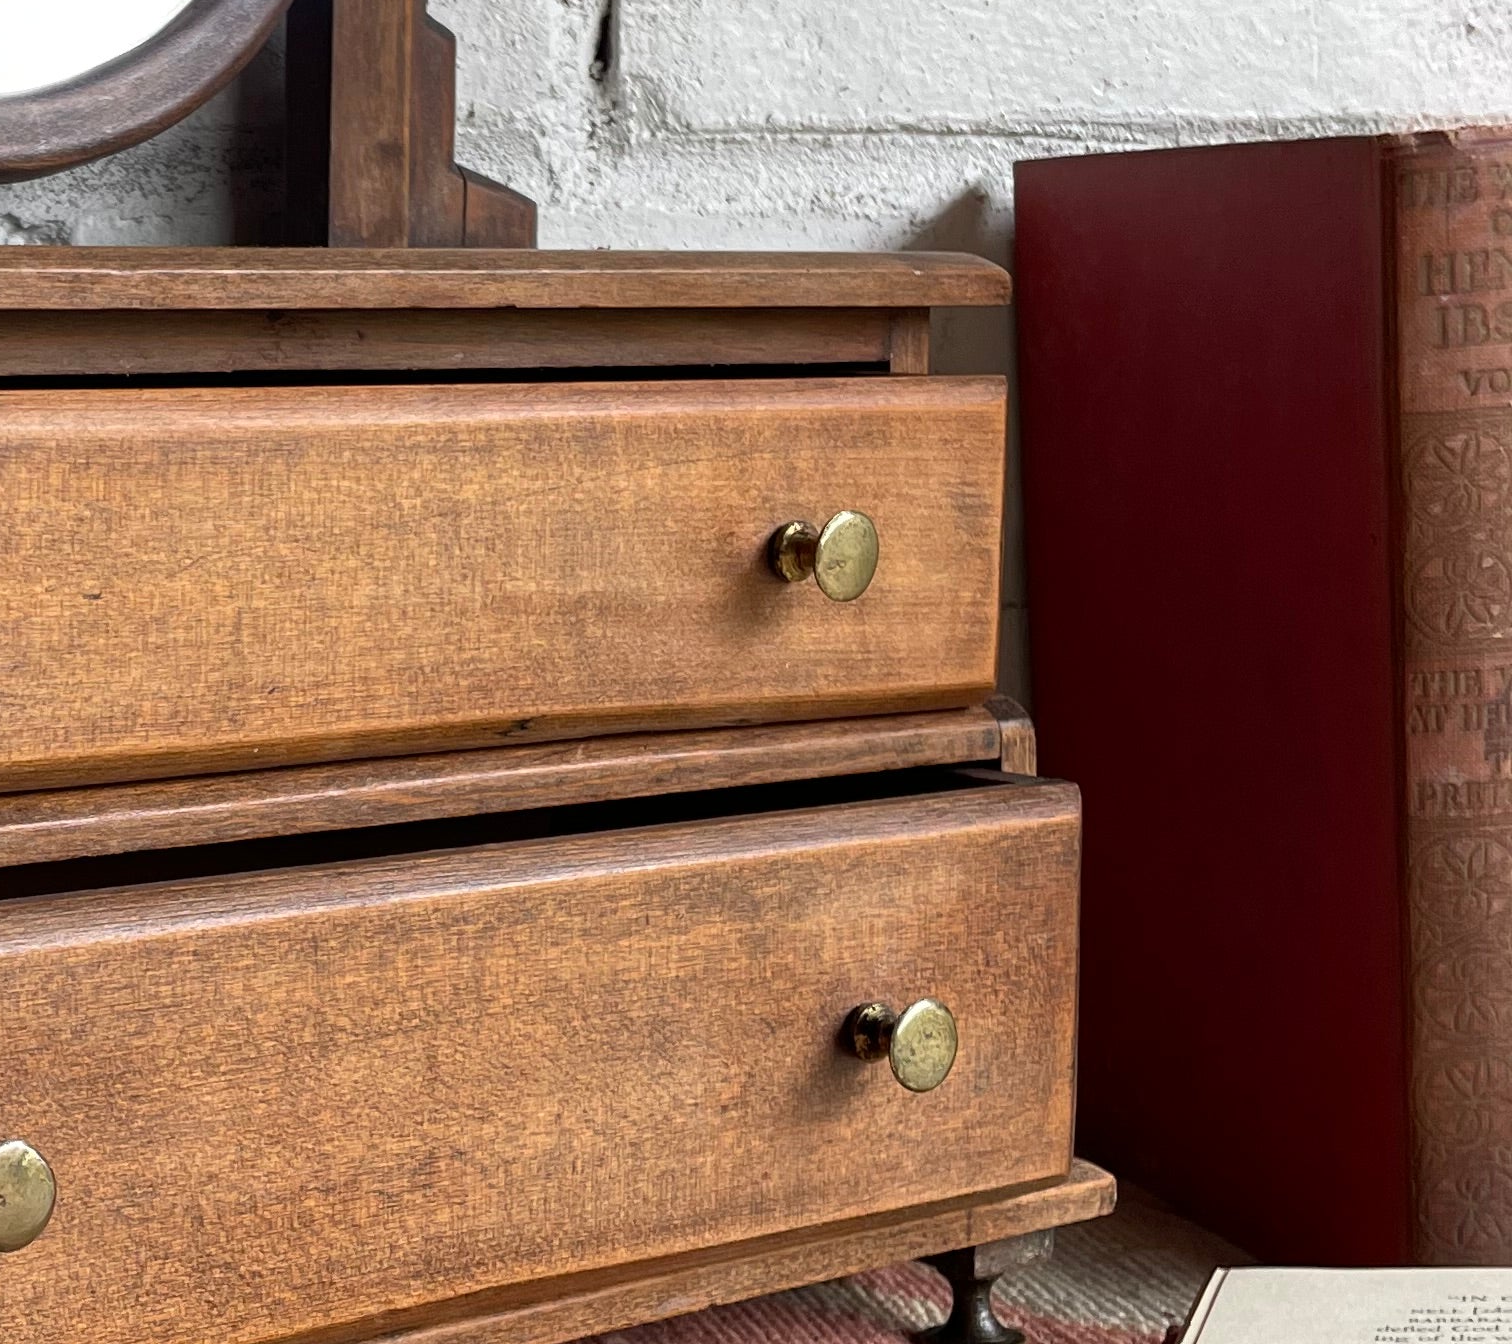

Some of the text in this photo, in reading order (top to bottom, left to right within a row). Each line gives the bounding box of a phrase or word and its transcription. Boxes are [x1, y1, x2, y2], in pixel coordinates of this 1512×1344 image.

[1402, 164, 1477, 210] THE
[1408, 668, 1483, 698] THE
[1450, 1324, 1501, 1332] God
